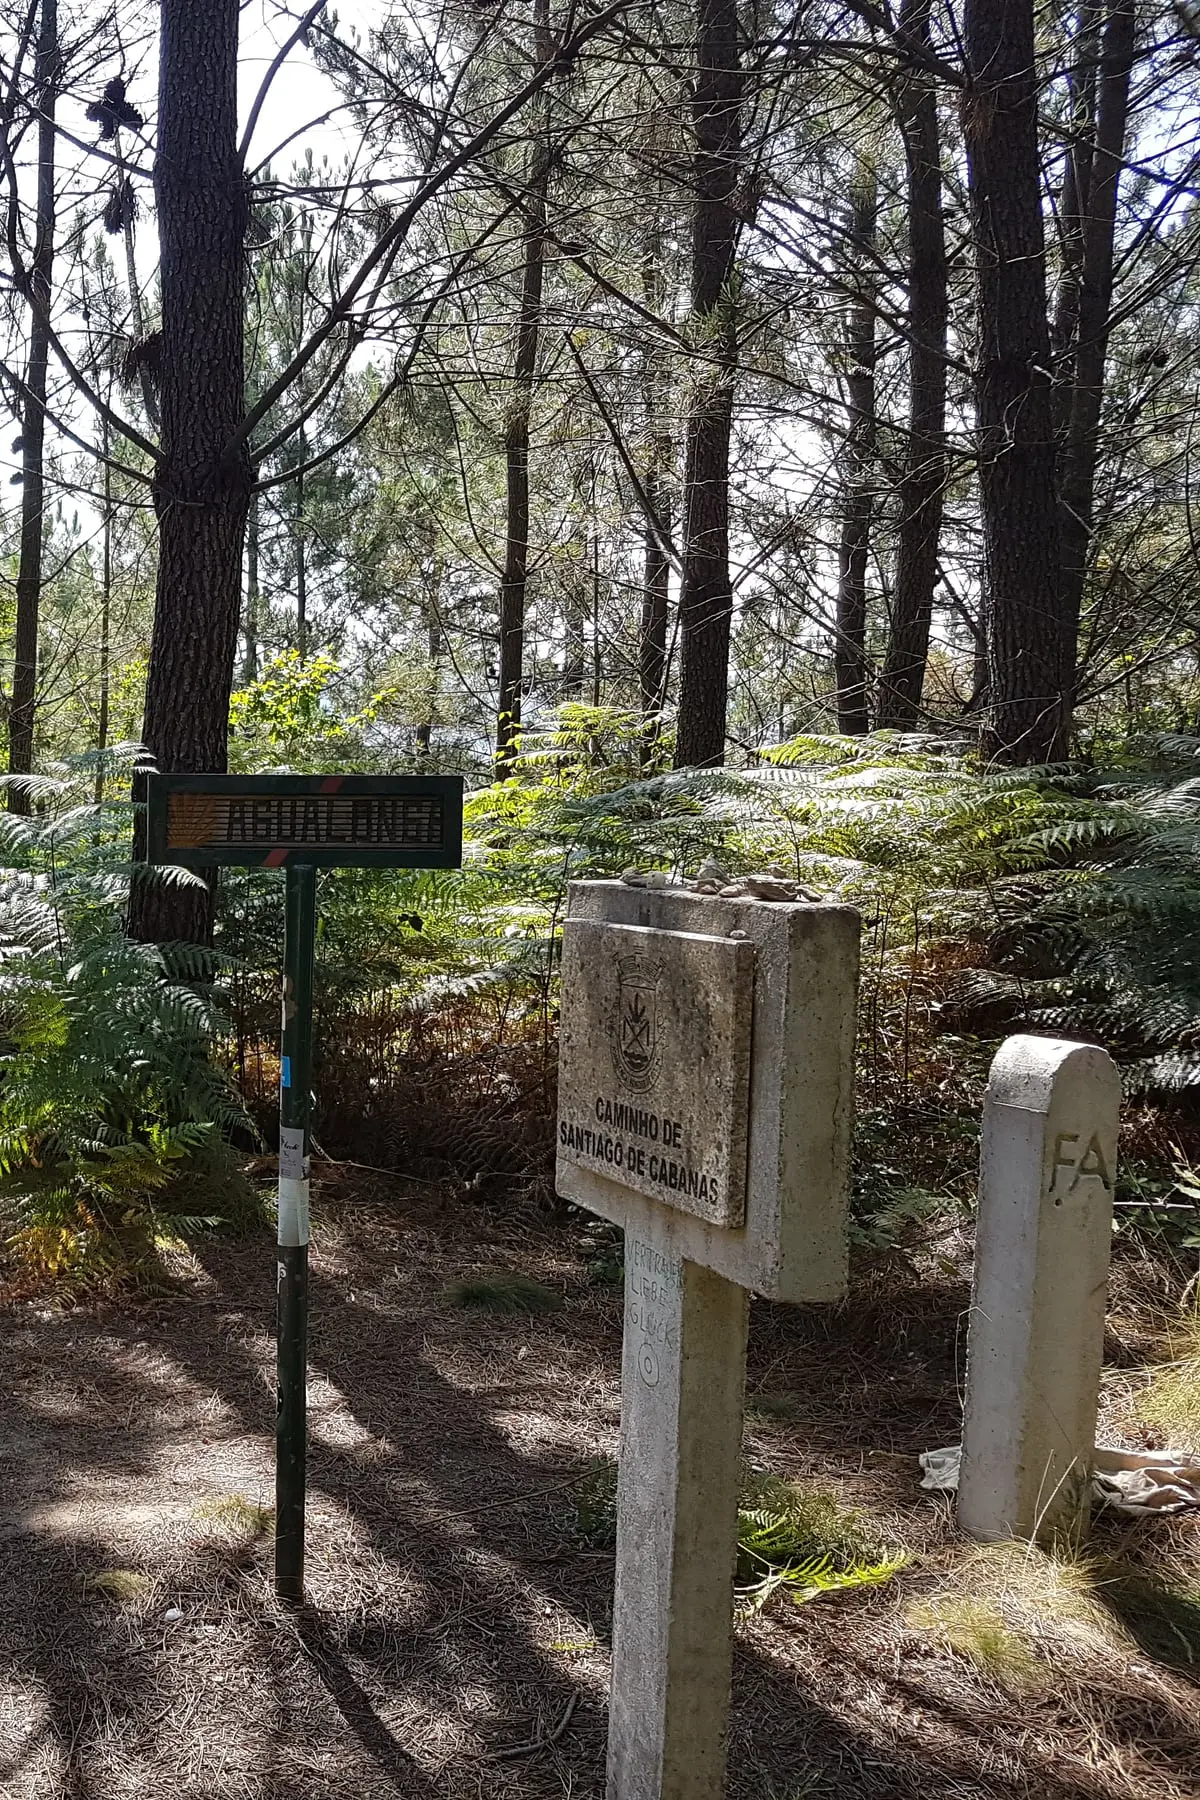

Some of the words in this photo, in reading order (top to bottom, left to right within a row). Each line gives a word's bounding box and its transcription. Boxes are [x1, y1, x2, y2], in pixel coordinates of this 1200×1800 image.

[595, 1096, 659, 1142] CAMINHO
[663, 1119, 683, 1149] DE
[559, 1120, 623, 1167] SANTIAGO
[627, 1145, 645, 1177] DE
[649, 1154, 719, 1206] CABANAS
[1048, 1131, 1113, 1193] FA
[630, 1267, 668, 1307] LIEBE
